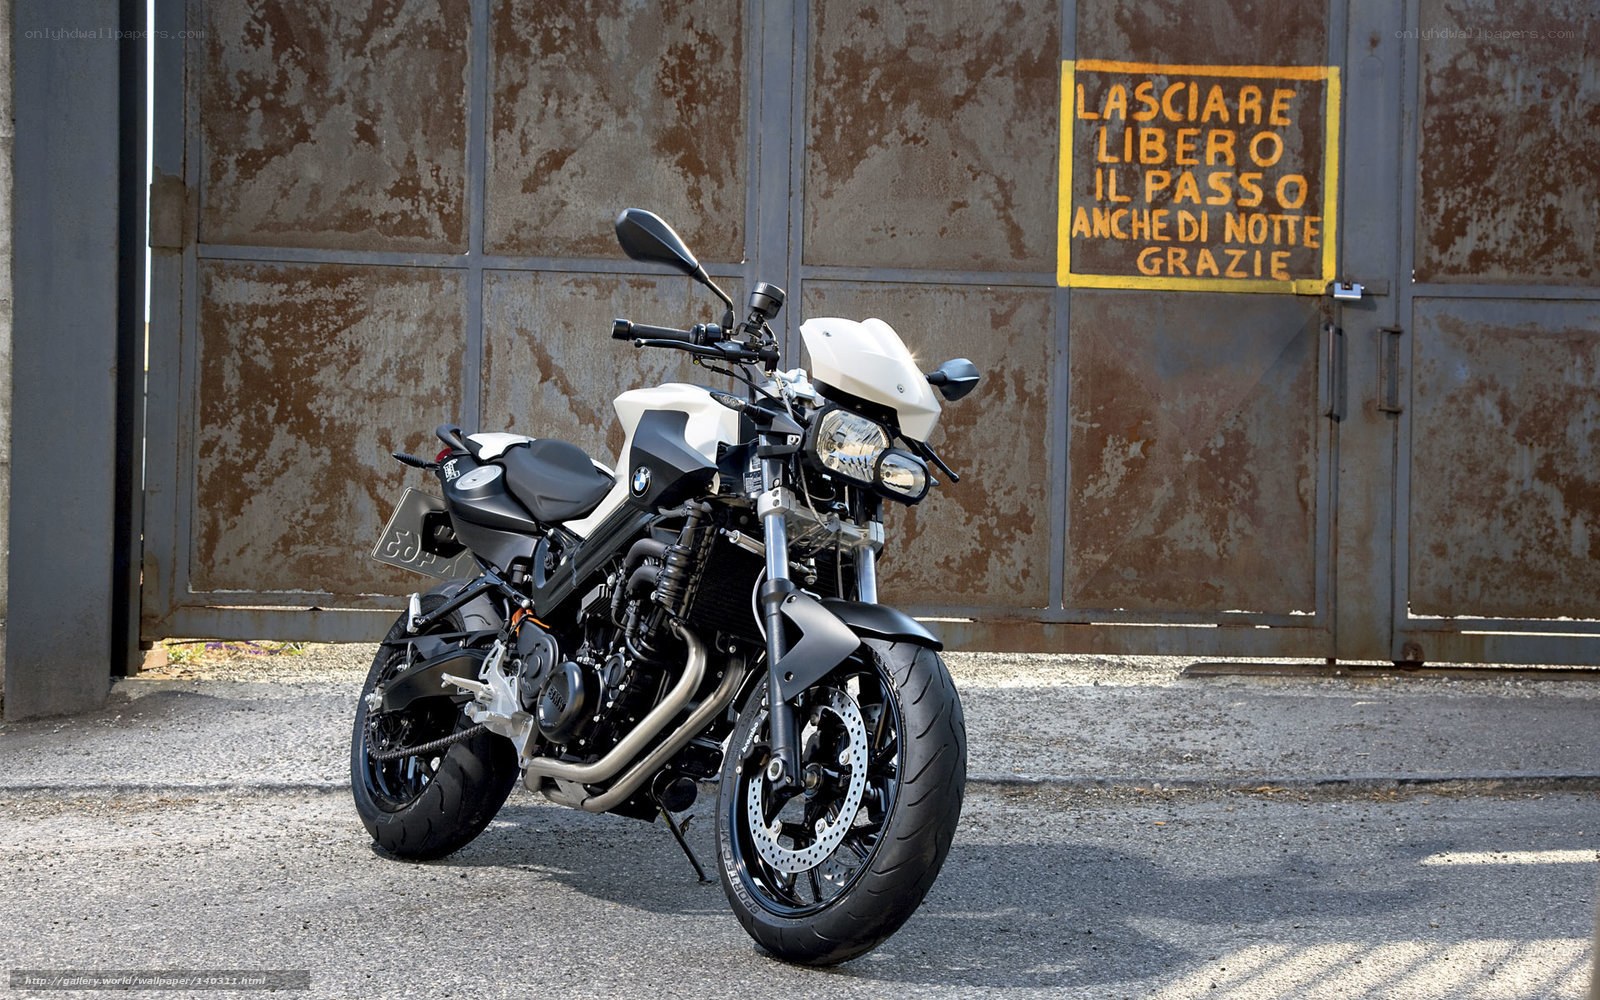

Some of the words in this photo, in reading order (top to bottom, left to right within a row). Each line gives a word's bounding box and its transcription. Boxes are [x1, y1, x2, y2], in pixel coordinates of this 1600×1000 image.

[1076, 81, 1297, 126] LASCIARE
[1097, 126, 1284, 167] LIBERO
[1095, 168, 1132, 203] IL
[1145, 170, 1308, 209] PASSO
[1071, 206, 1171, 240] ANCHE
[1178, 210, 1208, 242] DI
[1224, 211, 1323, 248] NOTTE
[1136, 246, 1292, 281] GRAZIE
[723, 845, 760, 915] SPORTEC
